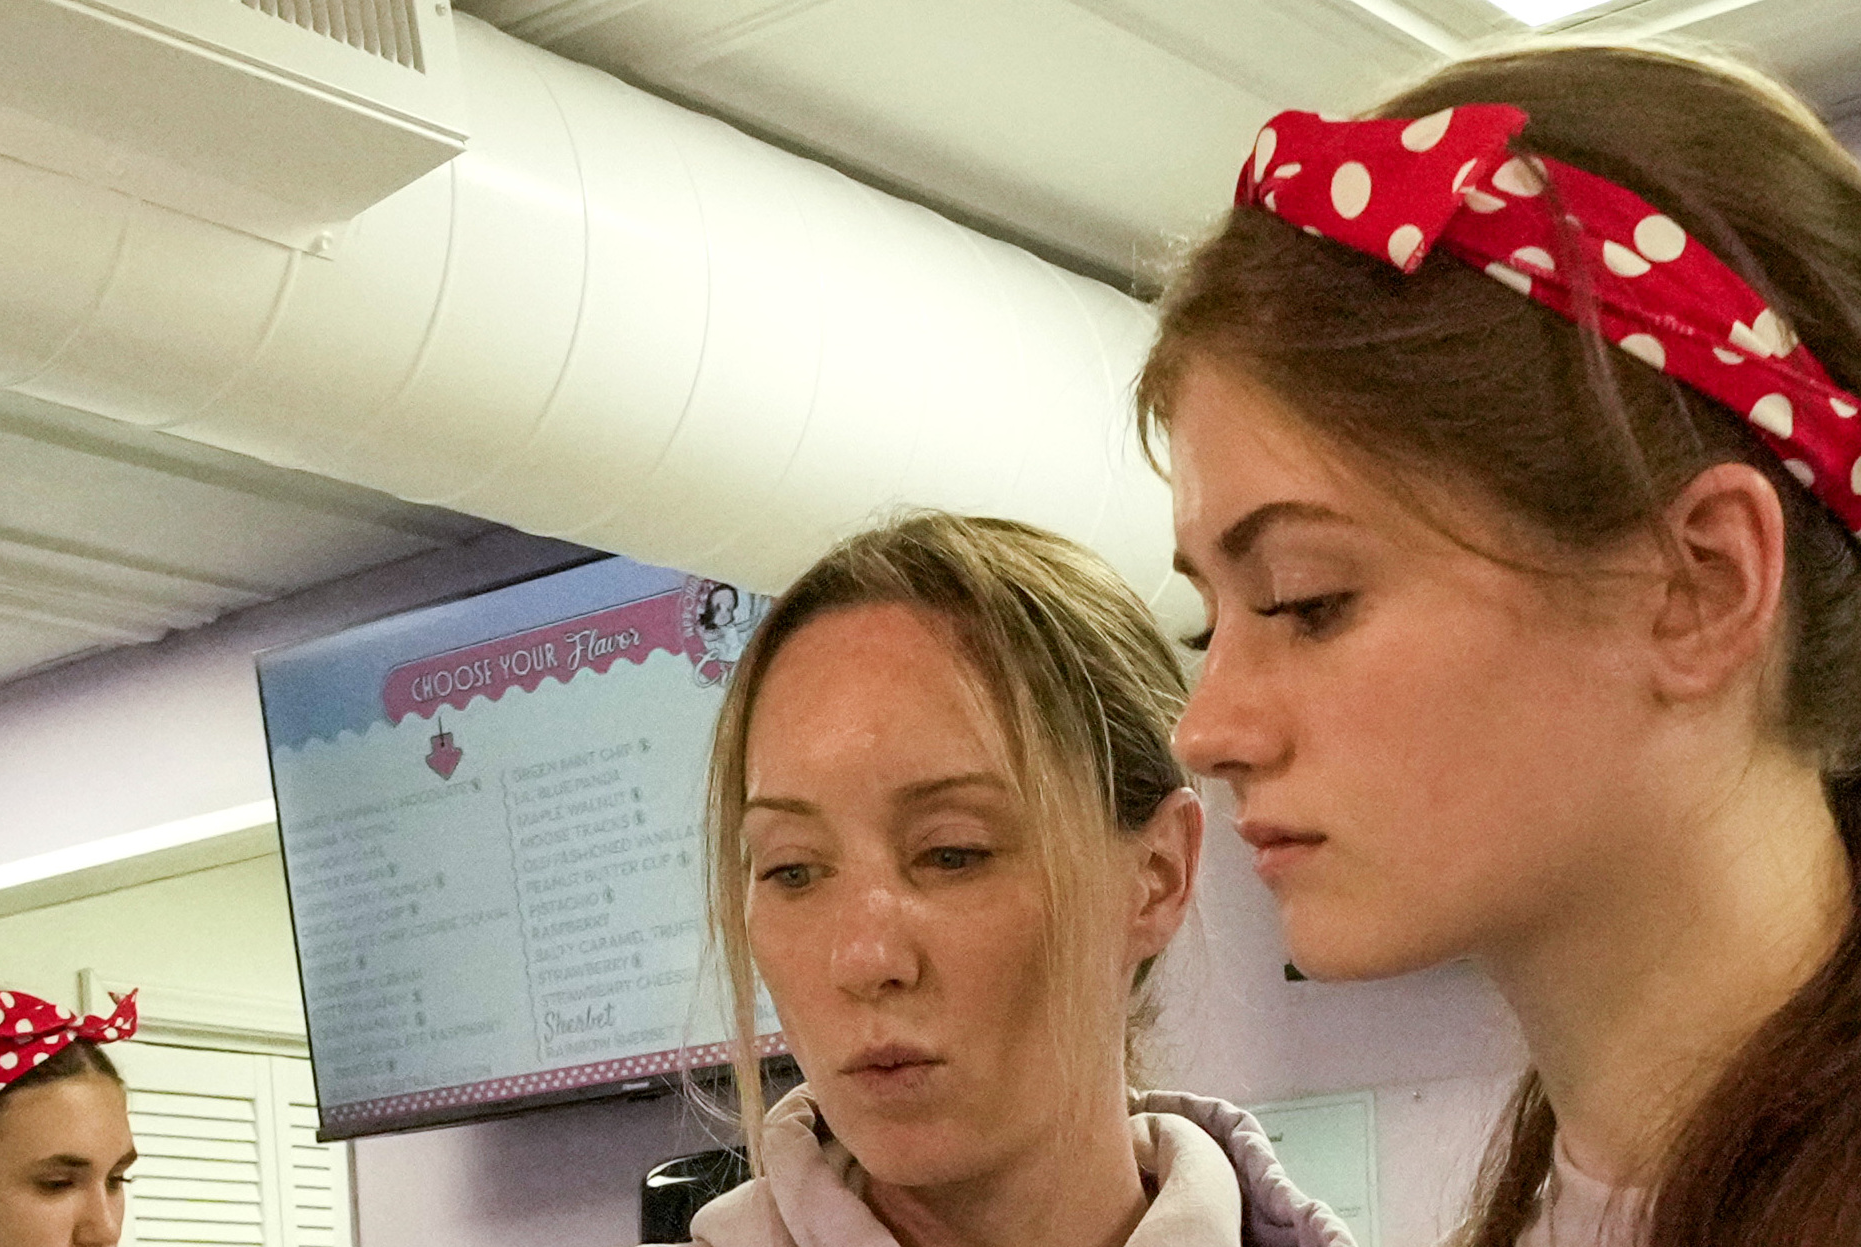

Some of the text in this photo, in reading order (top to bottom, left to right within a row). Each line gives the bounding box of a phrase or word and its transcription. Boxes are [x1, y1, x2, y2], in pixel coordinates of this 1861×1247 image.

[411, 627, 642, 703] CHOOSE YOUR Flavor
[543, 1002, 615, 1043] Sherbet
